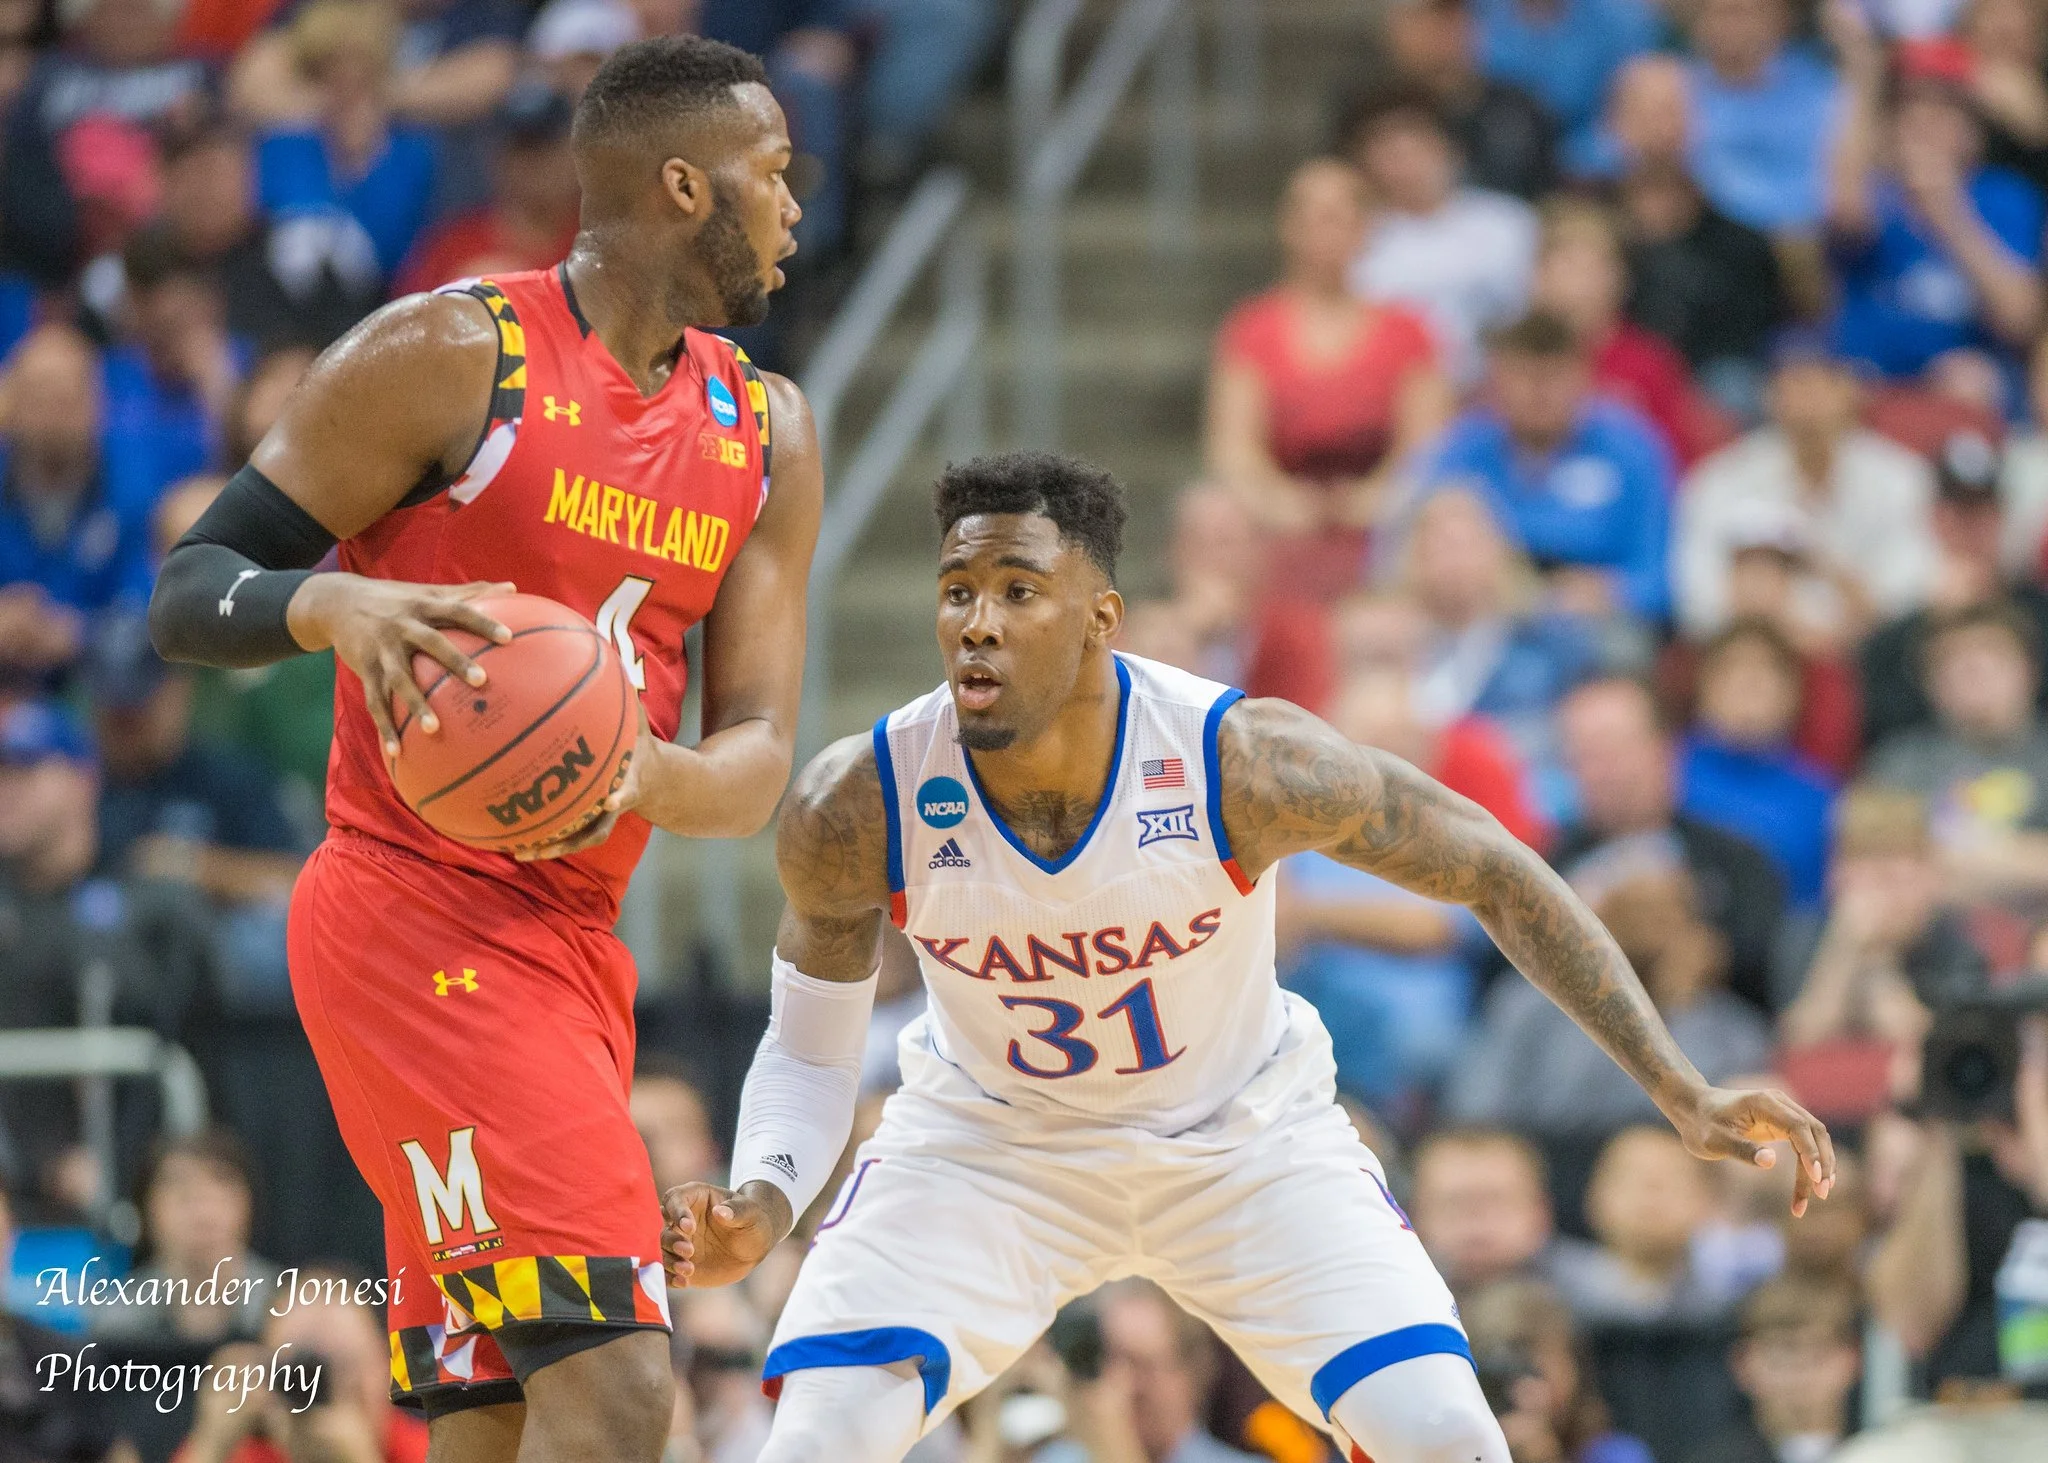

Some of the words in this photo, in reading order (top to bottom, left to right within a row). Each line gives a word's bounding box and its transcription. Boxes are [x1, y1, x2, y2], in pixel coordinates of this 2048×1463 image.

[543, 468, 731, 574] MARYLAND
[594, 573, 657, 695] 4
[486, 734, 596, 827] NCAA
[923, 801, 967, 817] NCAA
[928, 857, 971, 870] adidas
[1137, 805, 1198, 847] XII
[913, 908, 1222, 983] KANSAS
[997, 977, 1188, 1080] 31
[398, 1125, 501, 1247] M
[761, 1154, 799, 1178] adidas
